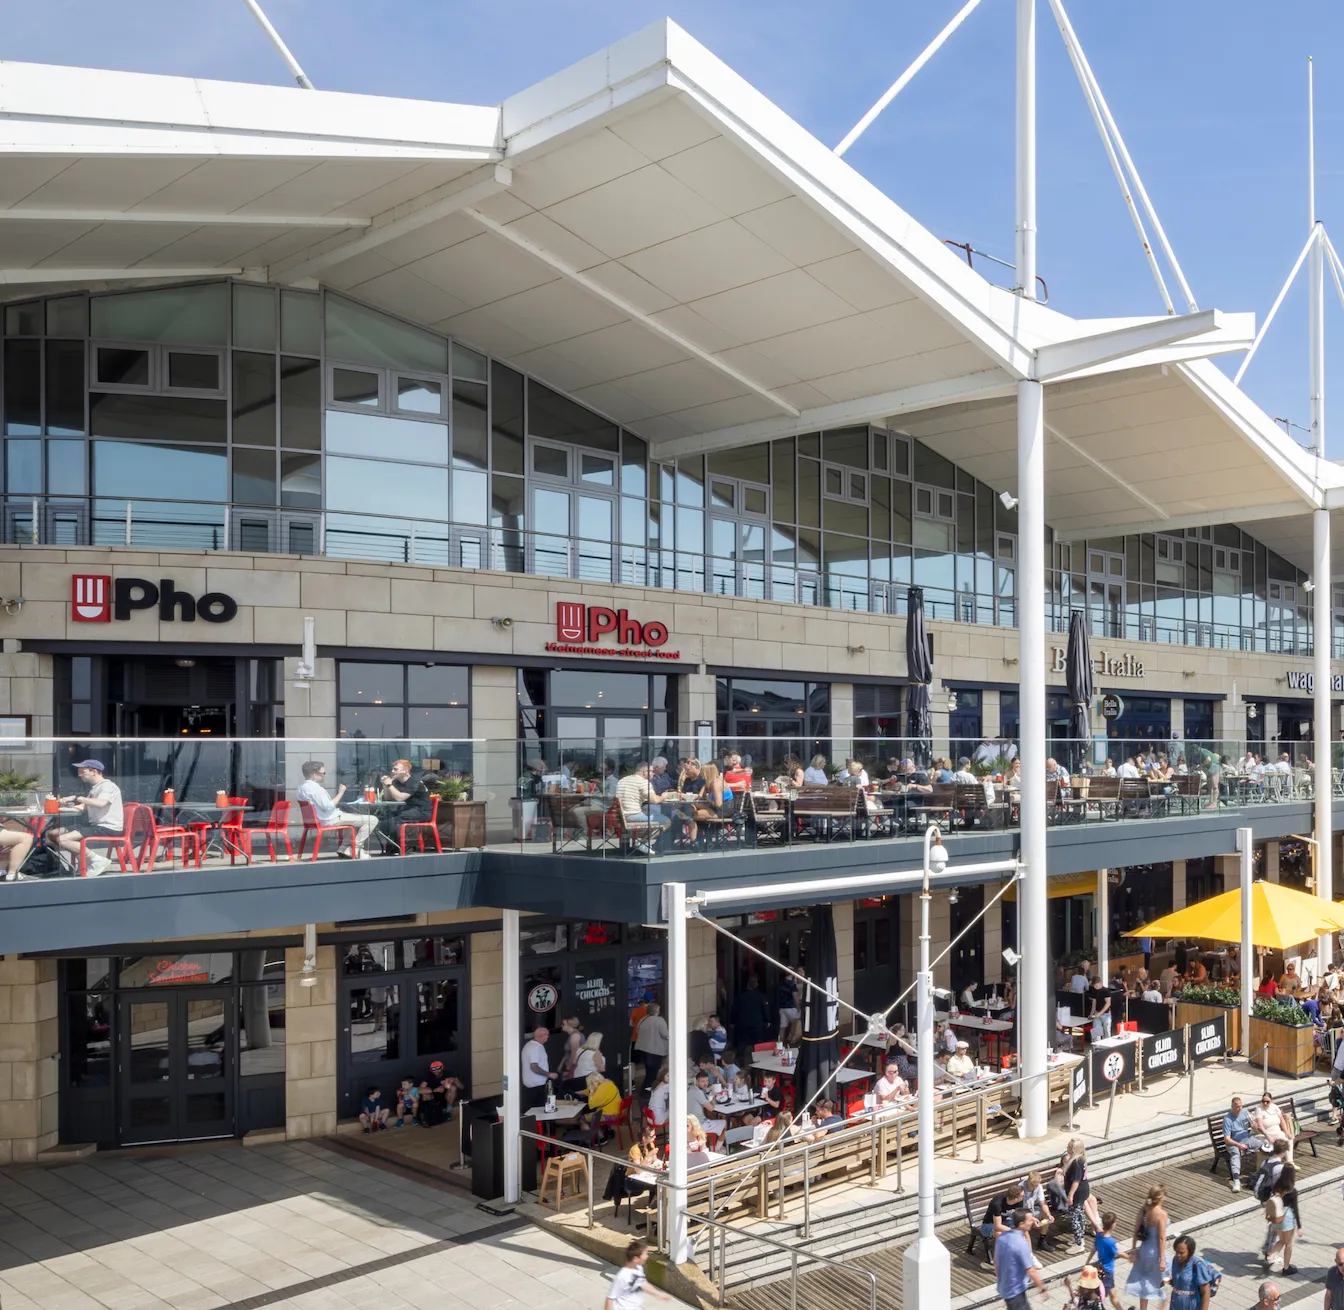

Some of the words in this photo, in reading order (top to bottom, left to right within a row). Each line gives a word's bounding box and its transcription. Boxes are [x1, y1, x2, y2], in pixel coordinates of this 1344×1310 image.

[114, 577, 238, 623] Pho
[588, 606, 669, 647] Pho
[545, 641, 616, 657] Vietnamese
[620, 649, 652, 659] street
[655, 650, 680, 660] food
[1101, 651, 1146, 677] Italia
[1104, 700, 1117, 708] Bella
[156, 959, 202, 973] Chicken
[586, 978, 604, 989] SLIM
[580, 987, 610, 1000] CHICKENS
[1200, 1024, 1215, 1040] SLIM
[1154, 1036, 1172, 1054] SLIM
[1196, 1035, 1221, 1055] CHICKENS
[1148, 1049, 1178, 1069] CHICKENS
